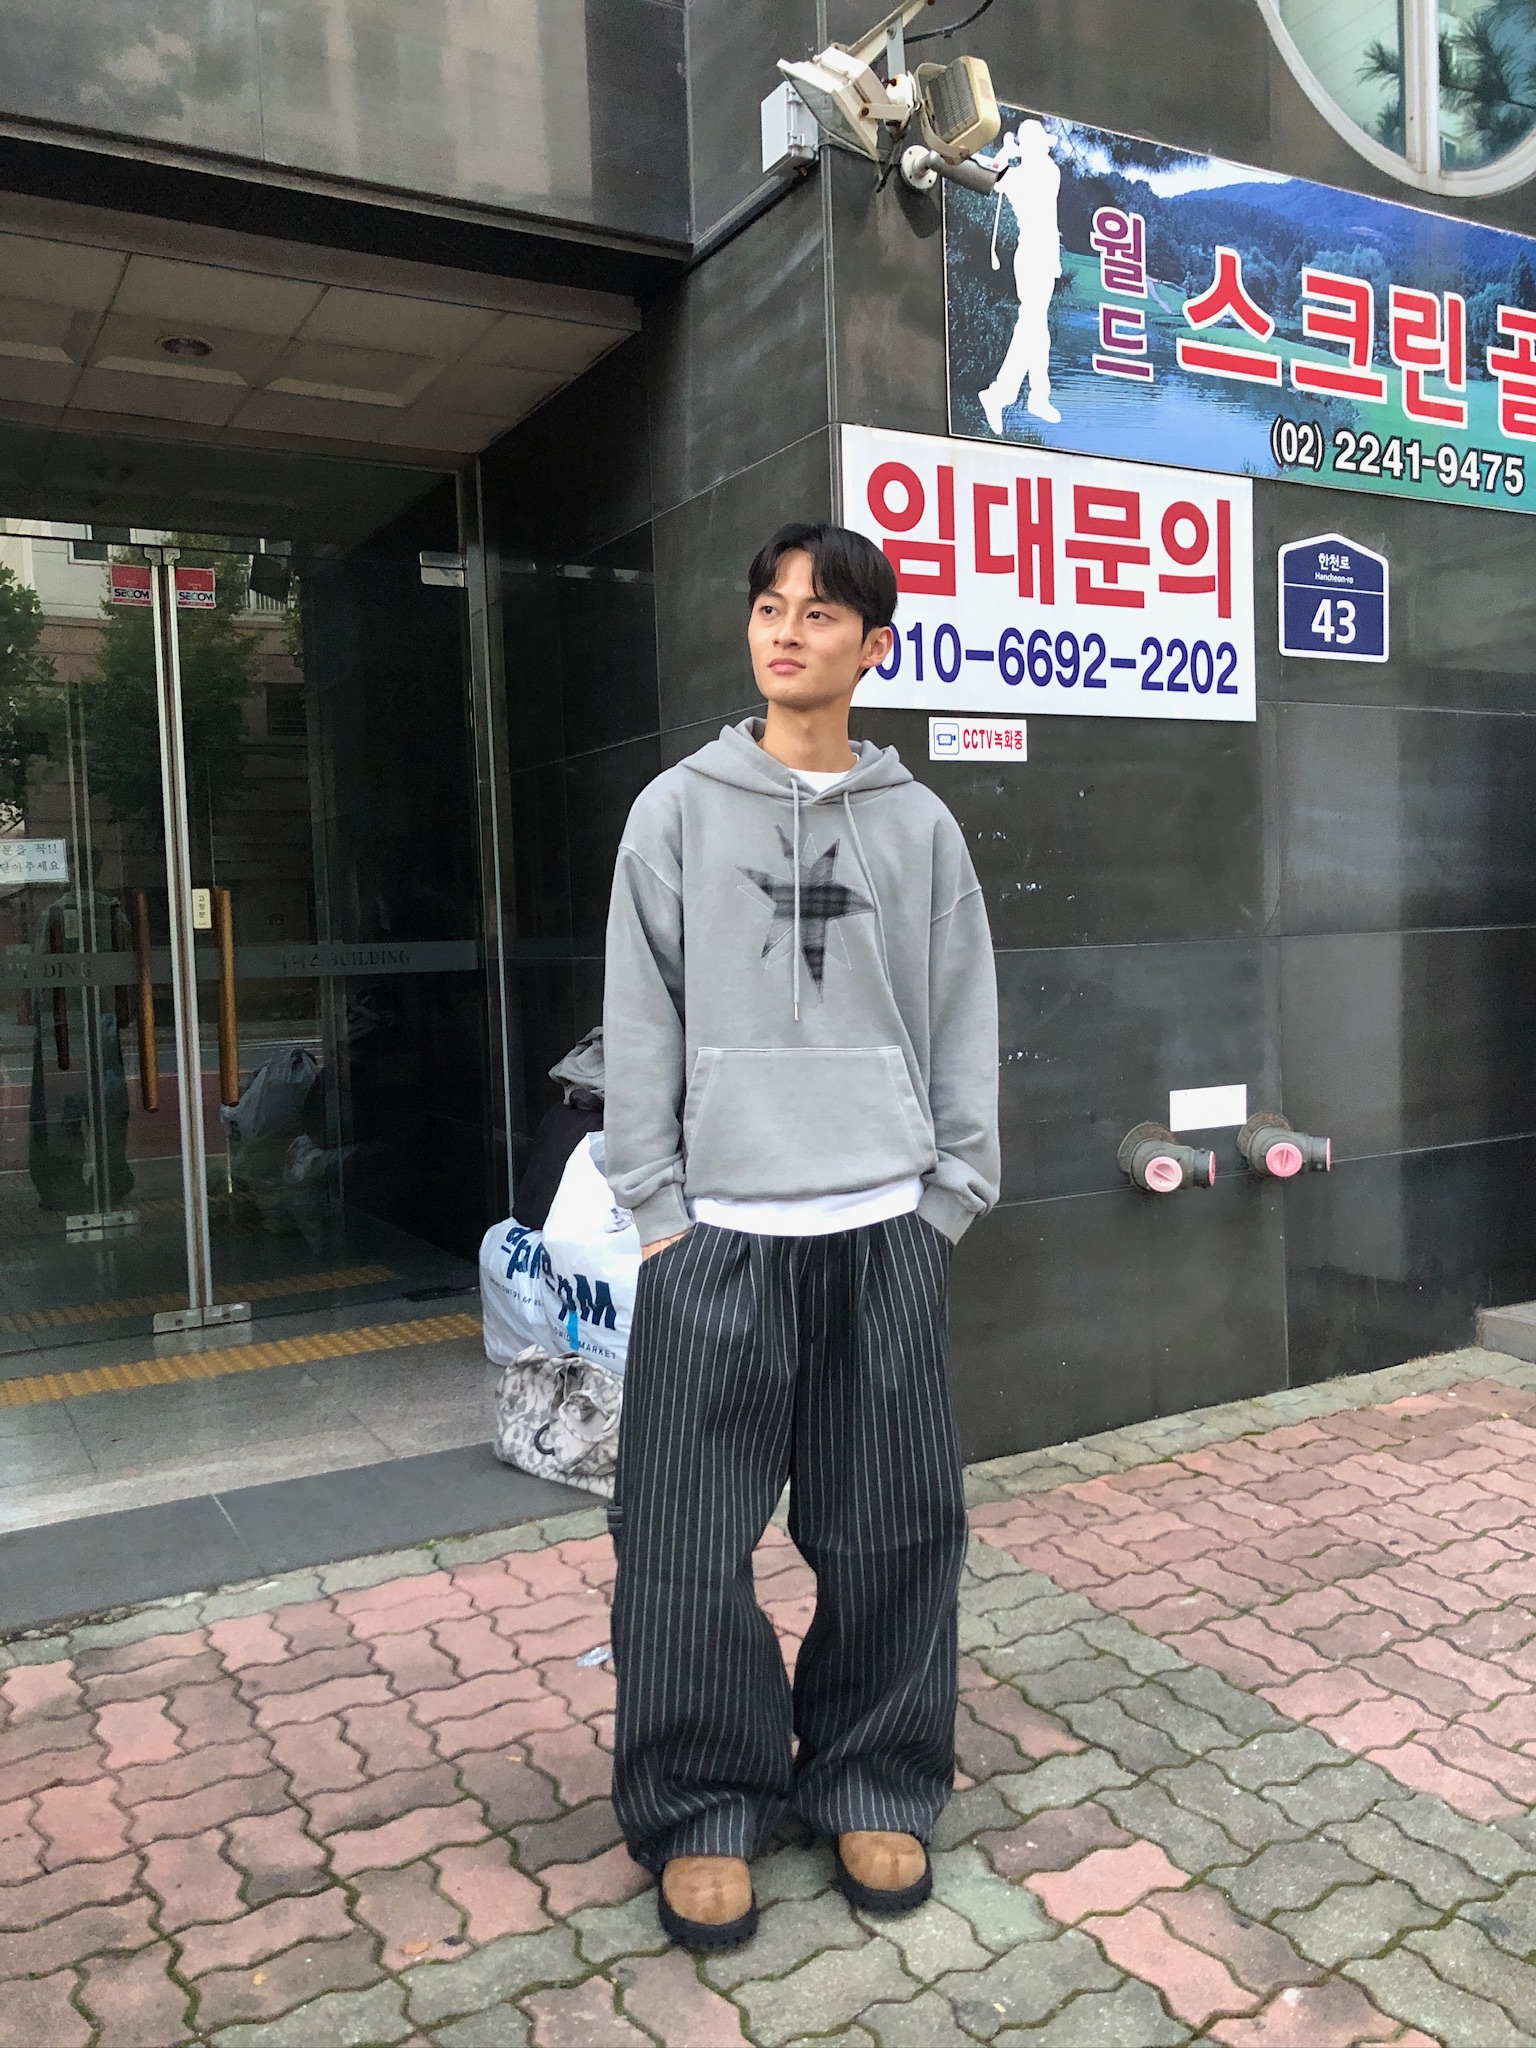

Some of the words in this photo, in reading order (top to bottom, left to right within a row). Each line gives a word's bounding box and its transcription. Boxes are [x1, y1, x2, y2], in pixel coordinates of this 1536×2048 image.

[1093, 207, 1153, 381] 월드
[1271, 415, 1324, 469] (02)
[1335, 431, 1525, 495] 2241-9475
[867, 461, 1232, 619] 임대문의
[1318, 553, 1350, 571] 한천로
[1315, 572, 1354, 584] Hancheon-ro
[114, 588, 150, 599] SECOM
[179, 591, 213, 602] SECOM
[1311, 598, 1356, 644] 43
[331, 950, 410, 966] BUILDING
[578, 1341, 616, 1359] MARKET
